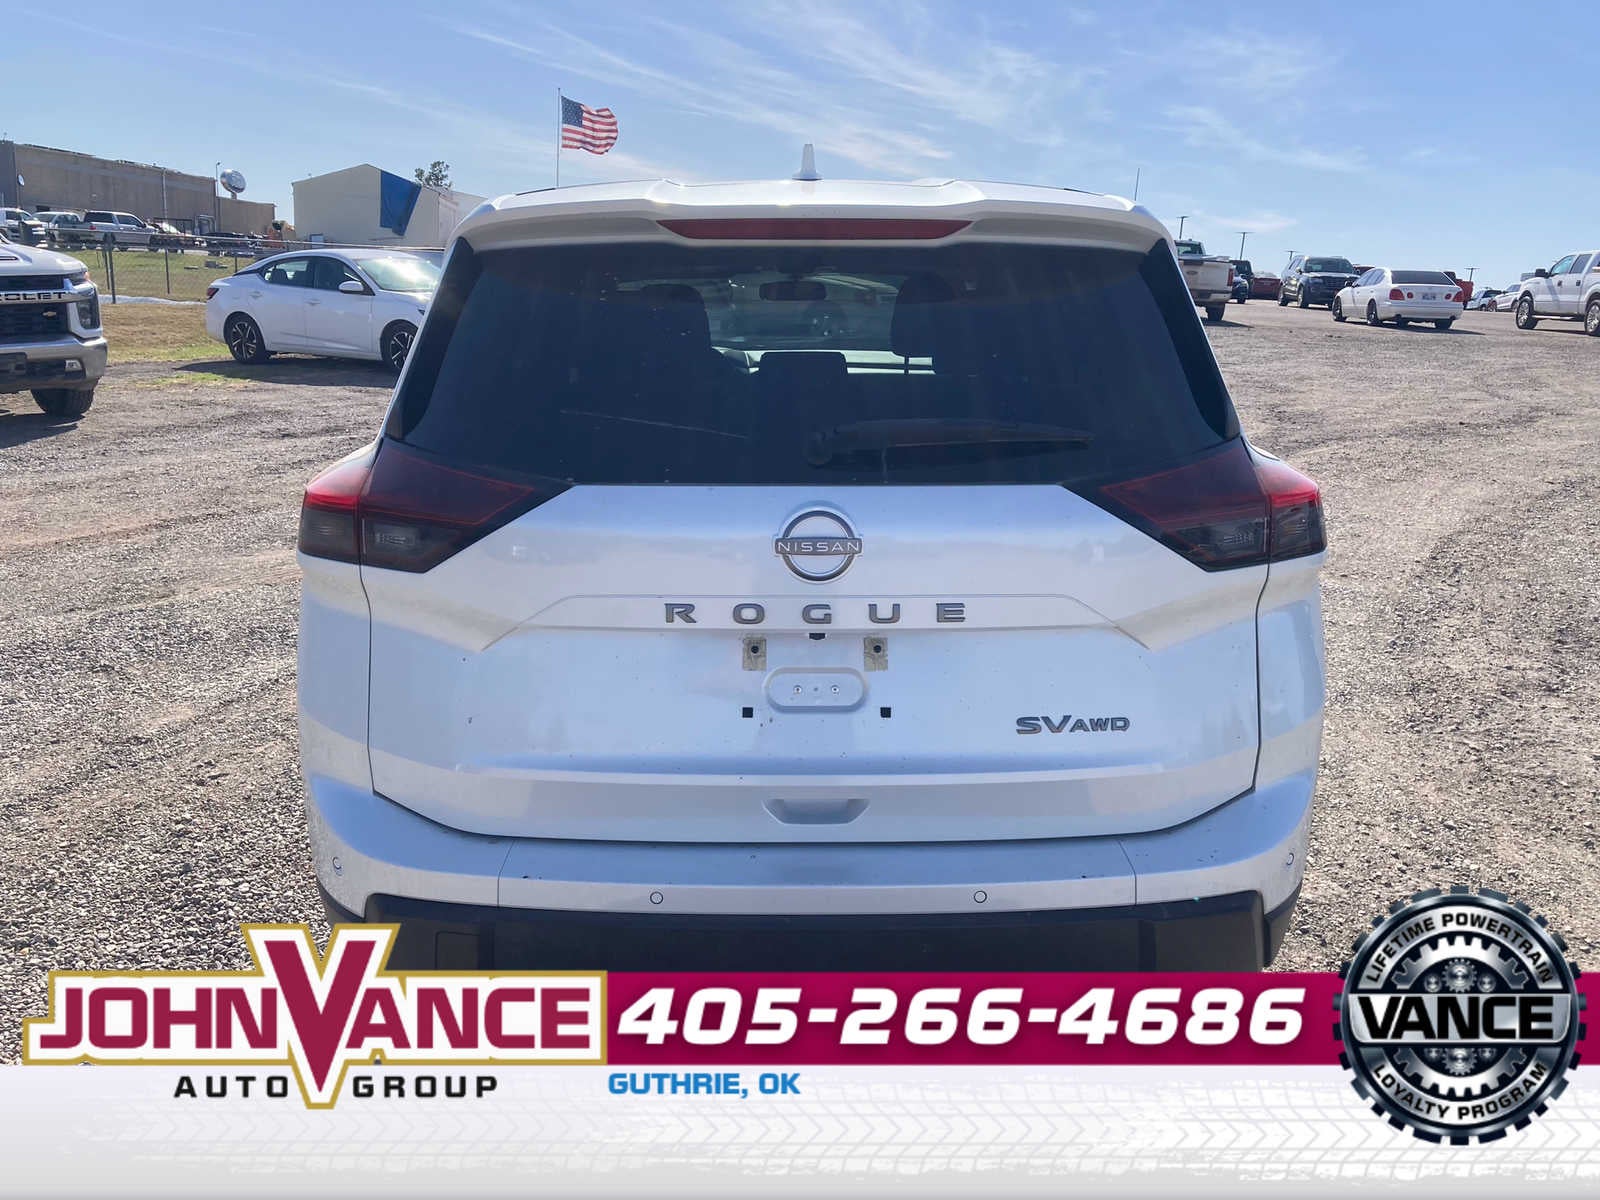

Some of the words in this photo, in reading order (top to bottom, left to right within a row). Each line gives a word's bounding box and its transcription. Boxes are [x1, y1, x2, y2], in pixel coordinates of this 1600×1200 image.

[0, 291, 66, 301] OLET
[777, 539, 860, 553] NISSAN
[664, 602, 966, 624] ROGUE
[1016, 715, 1072, 735] SV
[1069, 717, 1130, 732] AWD
